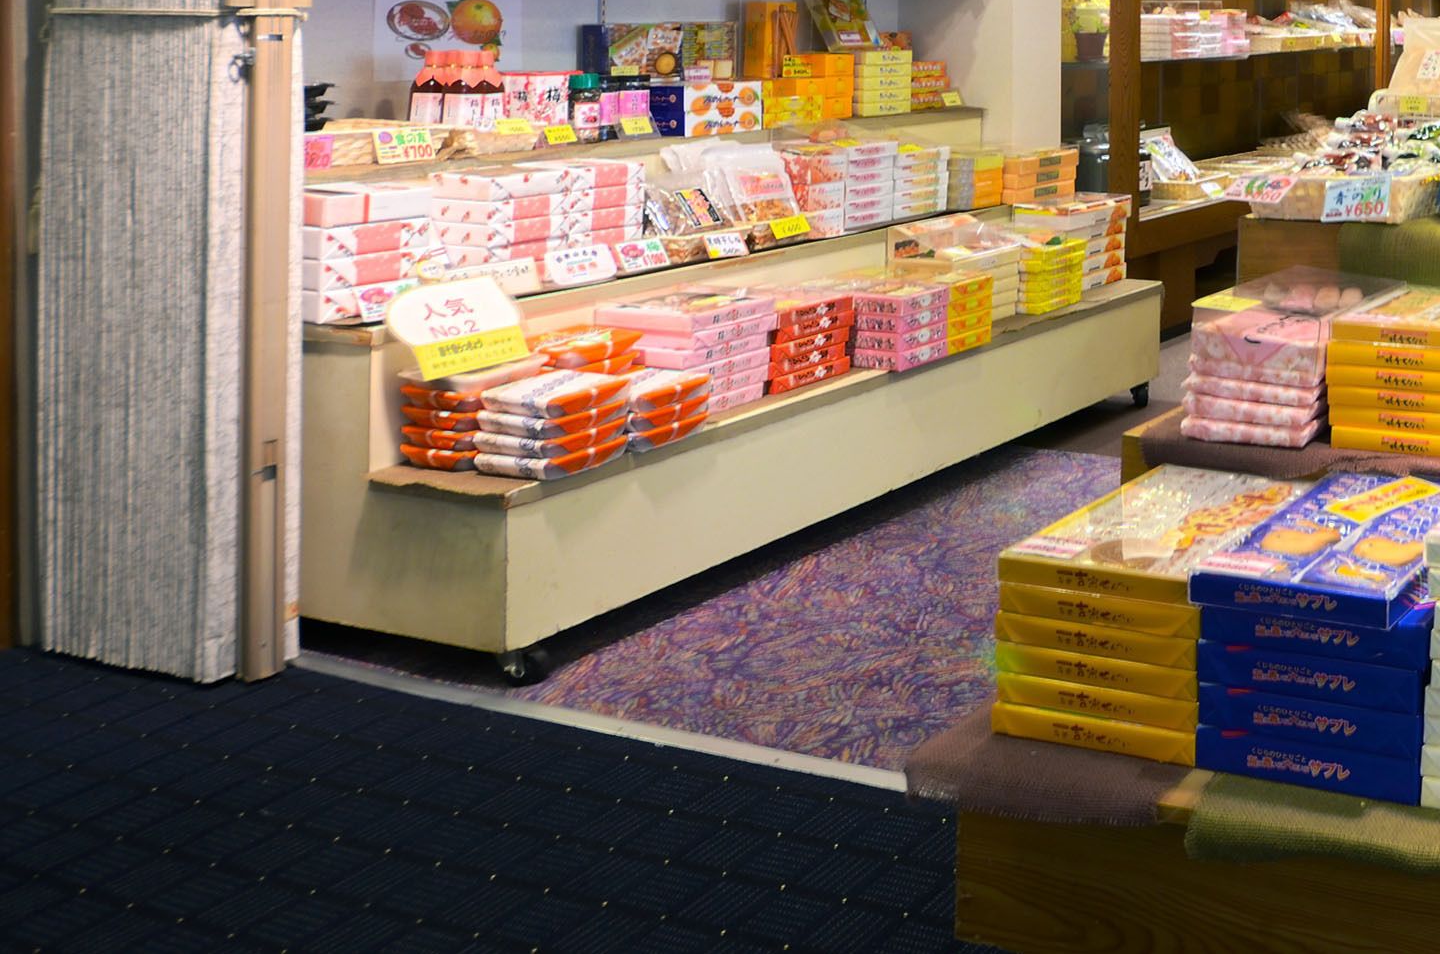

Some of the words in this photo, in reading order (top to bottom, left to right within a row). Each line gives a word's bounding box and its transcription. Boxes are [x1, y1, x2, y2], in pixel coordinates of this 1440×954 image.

[402, 145, 433, 159] ¥700
[1333, 187, 1383, 206] 青のり
[1344, 200, 1386, 217] ¥650
[423, 297, 475, 322] 人気
[428, 319, 481, 340] No.2
